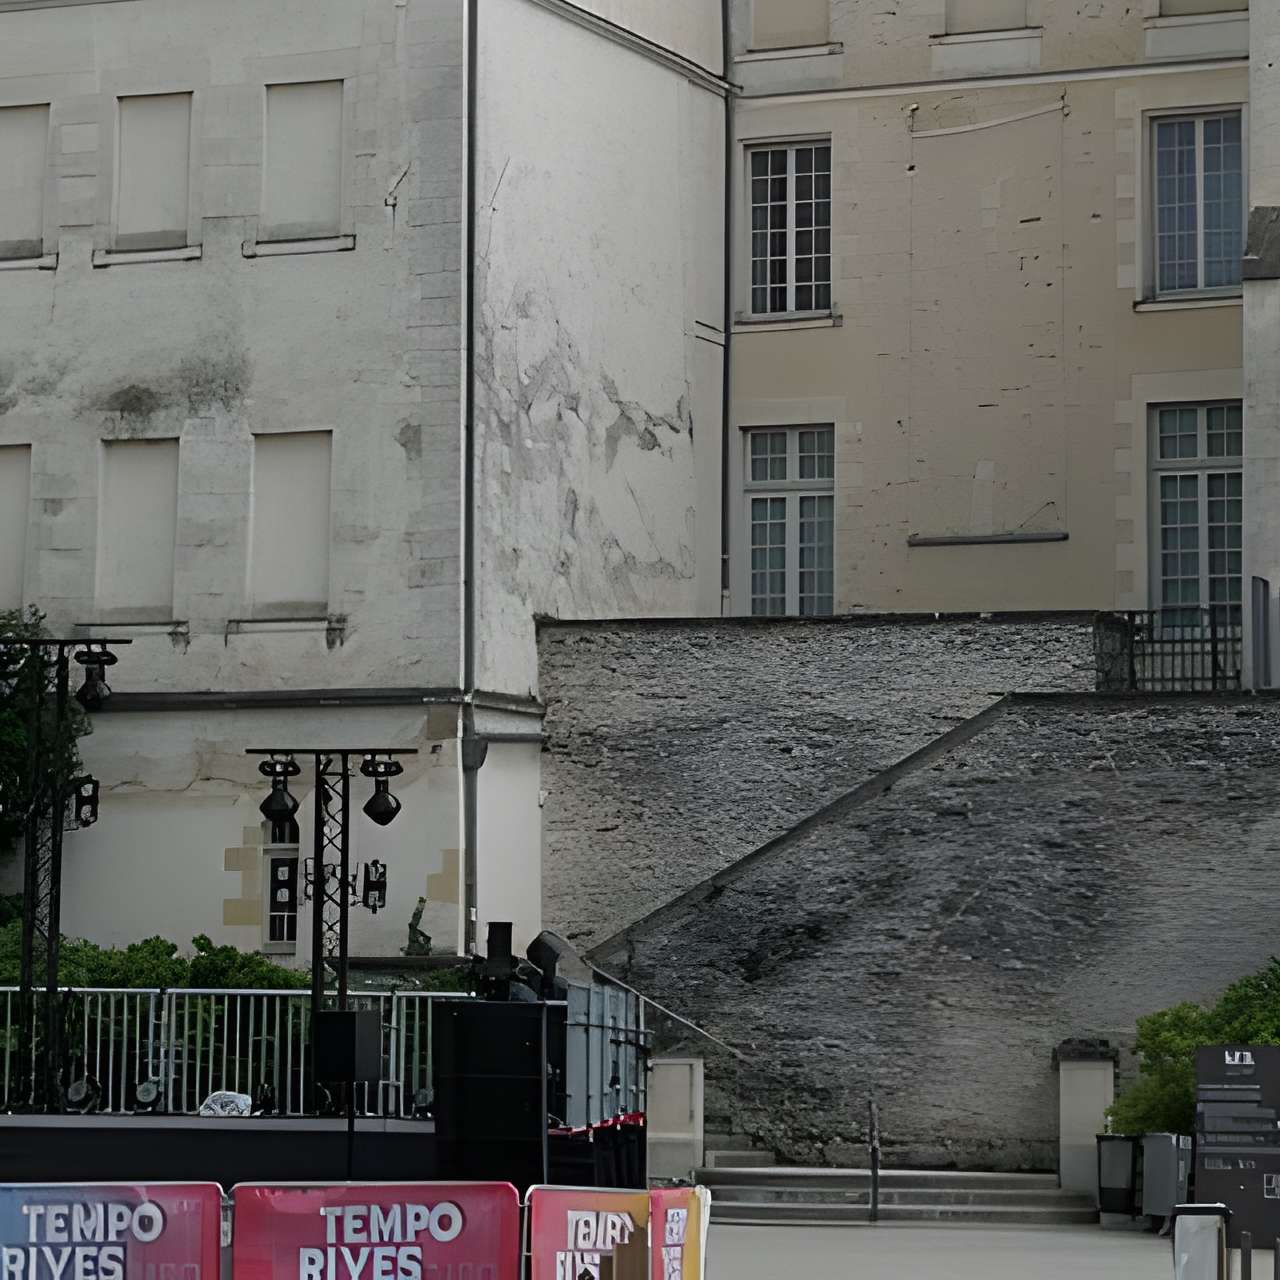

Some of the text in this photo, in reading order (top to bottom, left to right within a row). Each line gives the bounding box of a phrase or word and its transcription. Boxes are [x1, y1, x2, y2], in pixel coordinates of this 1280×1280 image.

[22, 1201, 164, 1242] TEMPO
[320, 1201, 463, 1242] TEMPO
[2, 1245, 124, 1280] RIVES
[299, 1245, 422, 1280] RIVES
